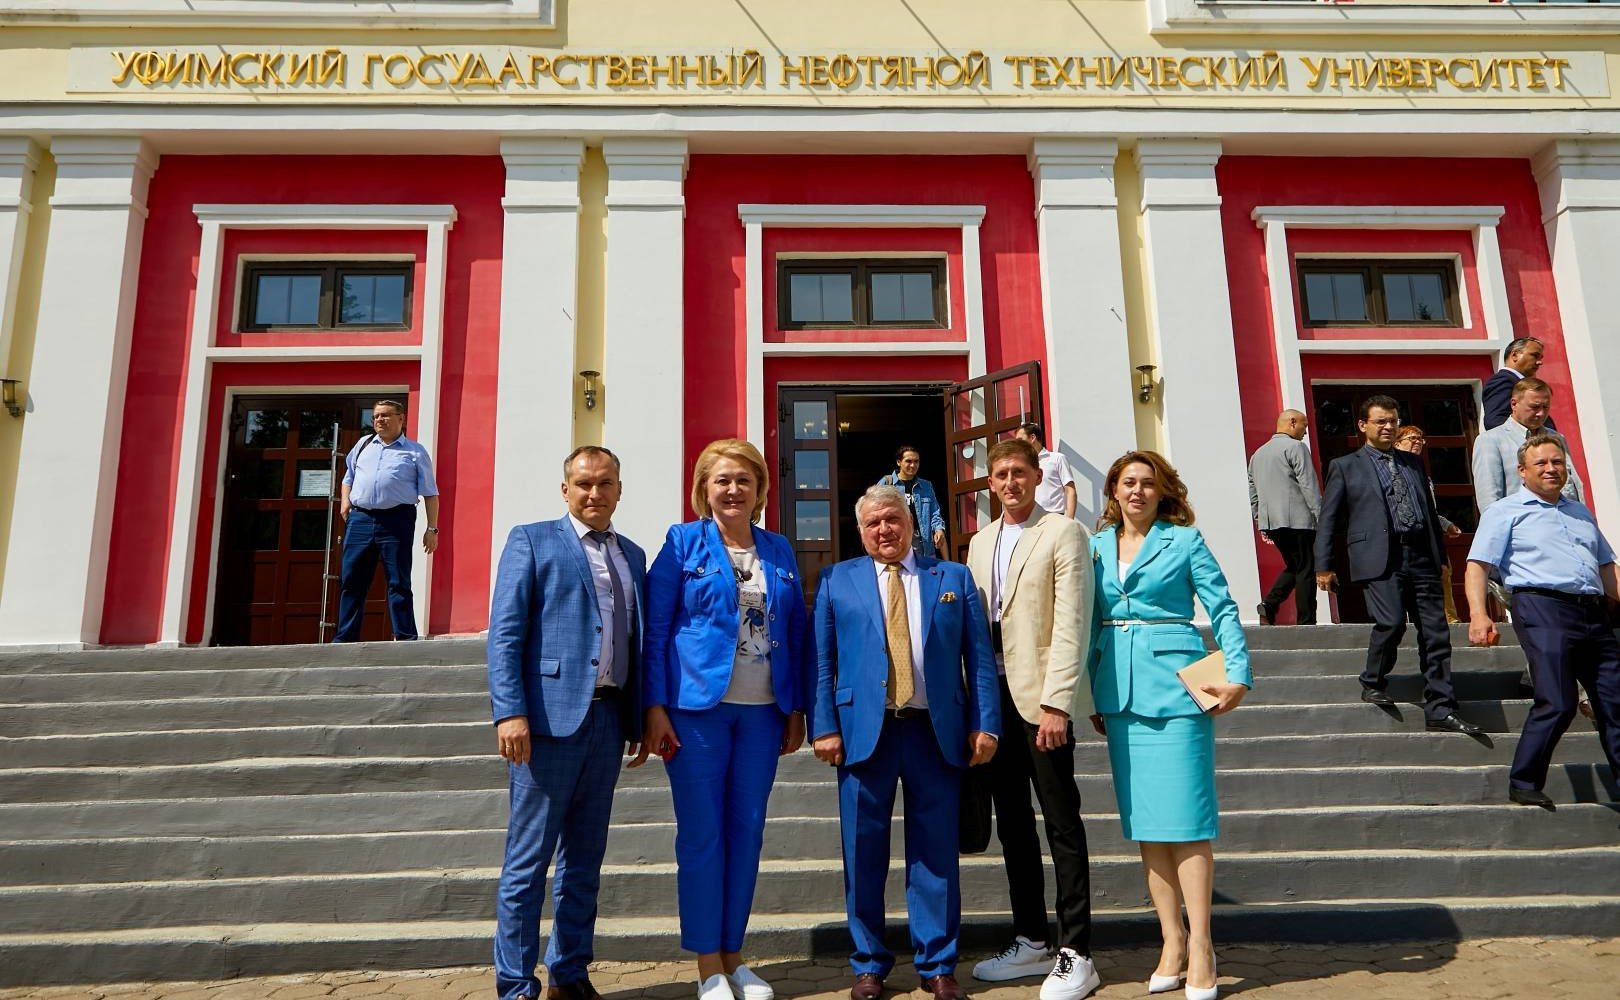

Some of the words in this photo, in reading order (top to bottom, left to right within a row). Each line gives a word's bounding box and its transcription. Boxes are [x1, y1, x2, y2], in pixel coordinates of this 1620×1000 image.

[112, 48, 344, 85] УФИМСКИЙ
[363, 49, 766, 87] ГОСУДАРСТВЕННЫЙ
[780, 50, 989, 87] НЕФТЯНОЙ
[1004, 50, 1287, 88] ТЕХНИЧЕСКИЙ
[1300, 56, 1569, 89] УНИВЕРСИТЕТ
